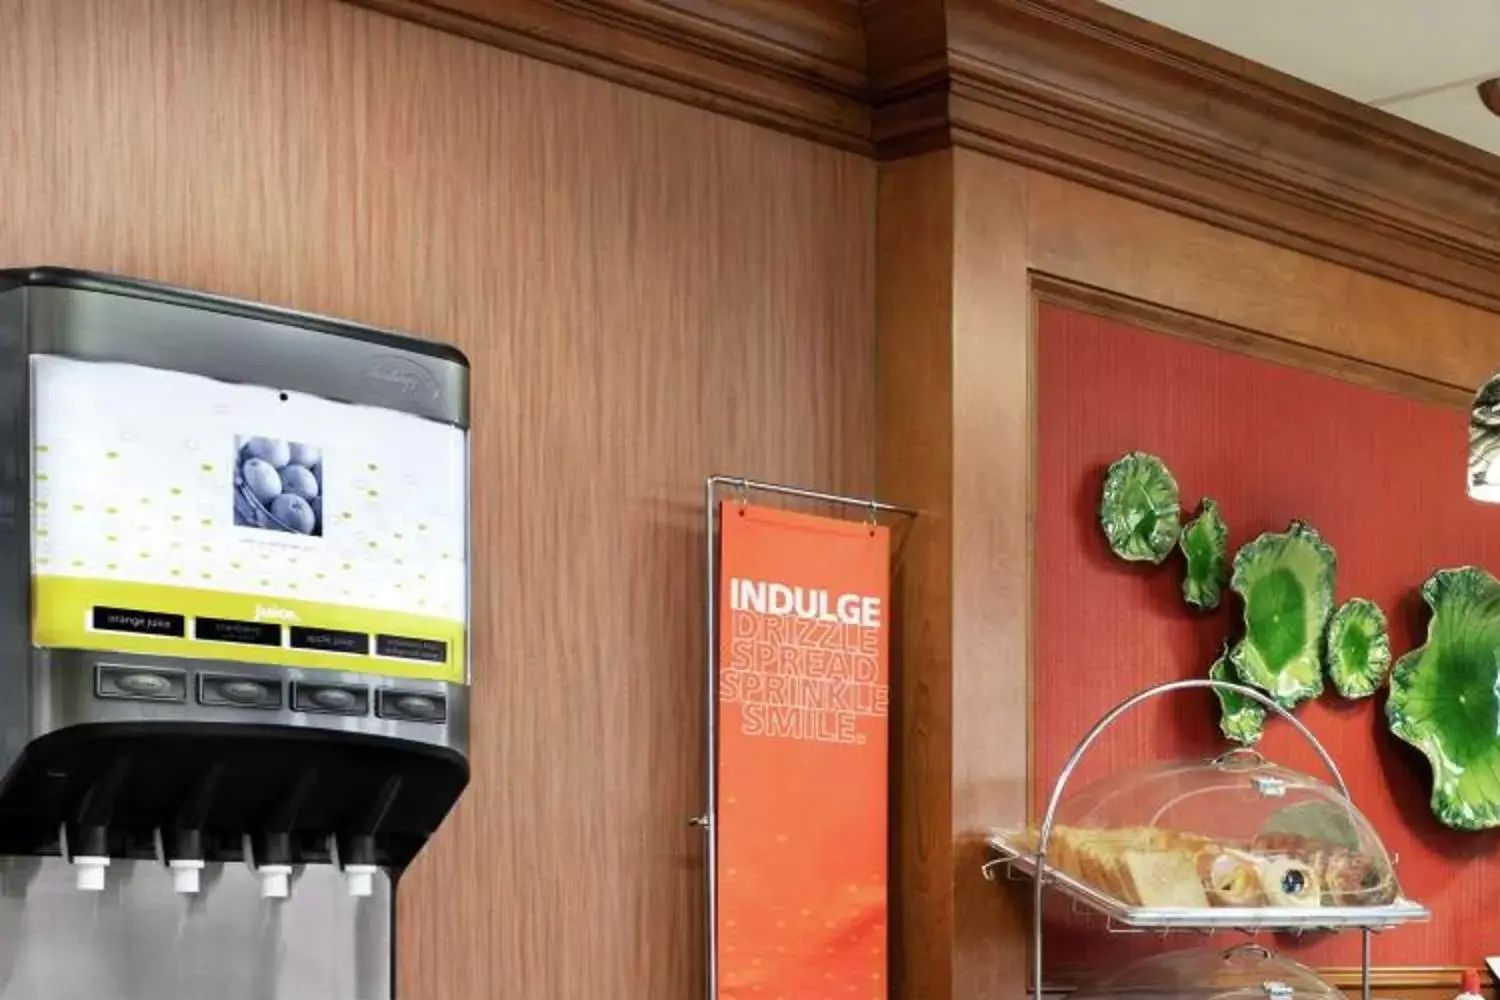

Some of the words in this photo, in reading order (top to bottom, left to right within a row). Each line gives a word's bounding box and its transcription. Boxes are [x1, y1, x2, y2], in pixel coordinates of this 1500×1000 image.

[107, 614, 145, 629] orange
[731, 577, 881, 627] INDULGE
[731, 609, 878, 656] DRIZZLE
[731, 638, 880, 685] SPREAD
[720, 667, 889, 717] SPRINKLE
[741, 701, 867, 745] SMILE.
